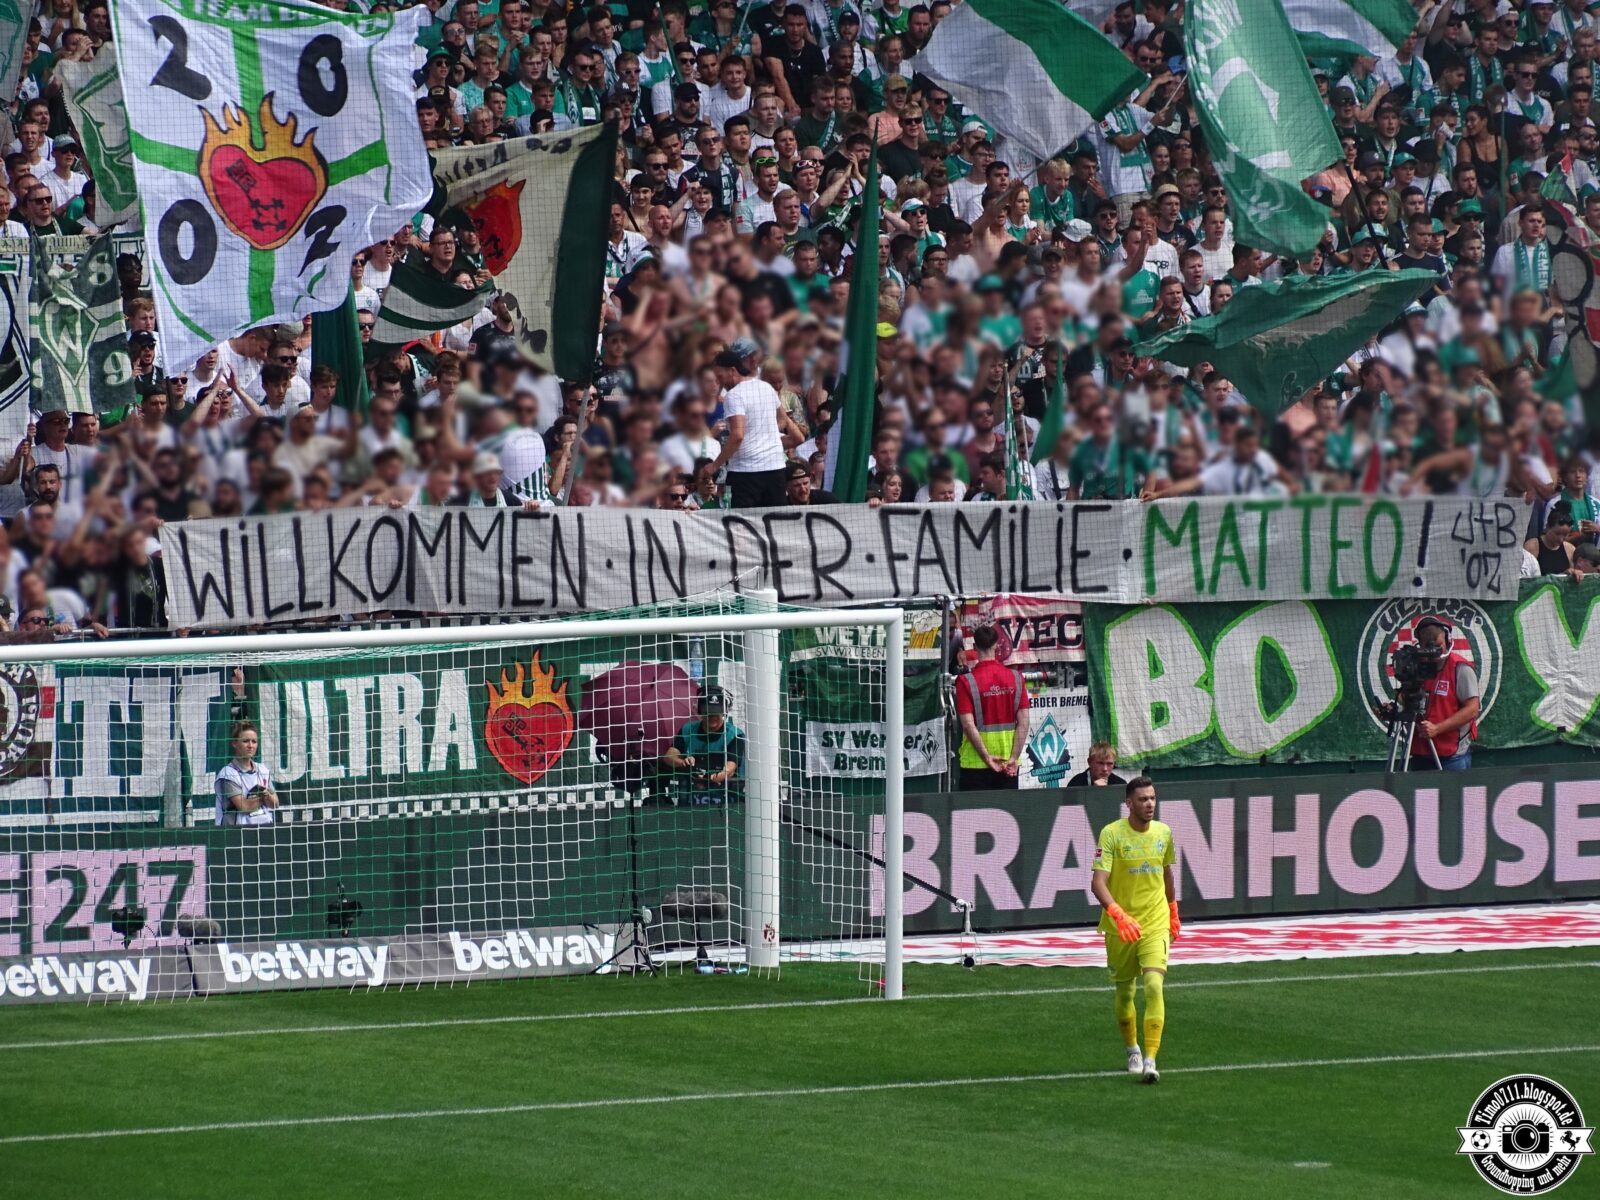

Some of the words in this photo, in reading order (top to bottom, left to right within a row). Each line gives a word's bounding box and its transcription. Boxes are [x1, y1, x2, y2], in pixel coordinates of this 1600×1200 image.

[624, 514, 687, 608] IN
[721, 511, 855, 601] DER
[1001, 614, 1084, 650] VEC
[1029, 696, 1057, 709] ERDER
[1059, 695, 1089, 707] BREME
[259, 670, 478, 783] ULTRA
[821, 730, 846, 748] SV
[851, 730, 923, 748] Werer
[834, 752, 910, 771] Bremn
[868, 780, 1600, 917] BRANHOUSE
[43, 860, 195, 943] 247
[217, 943, 388, 986] betway
[449, 931, 615, 974] betway
[0, 956, 150, 1000] etway
